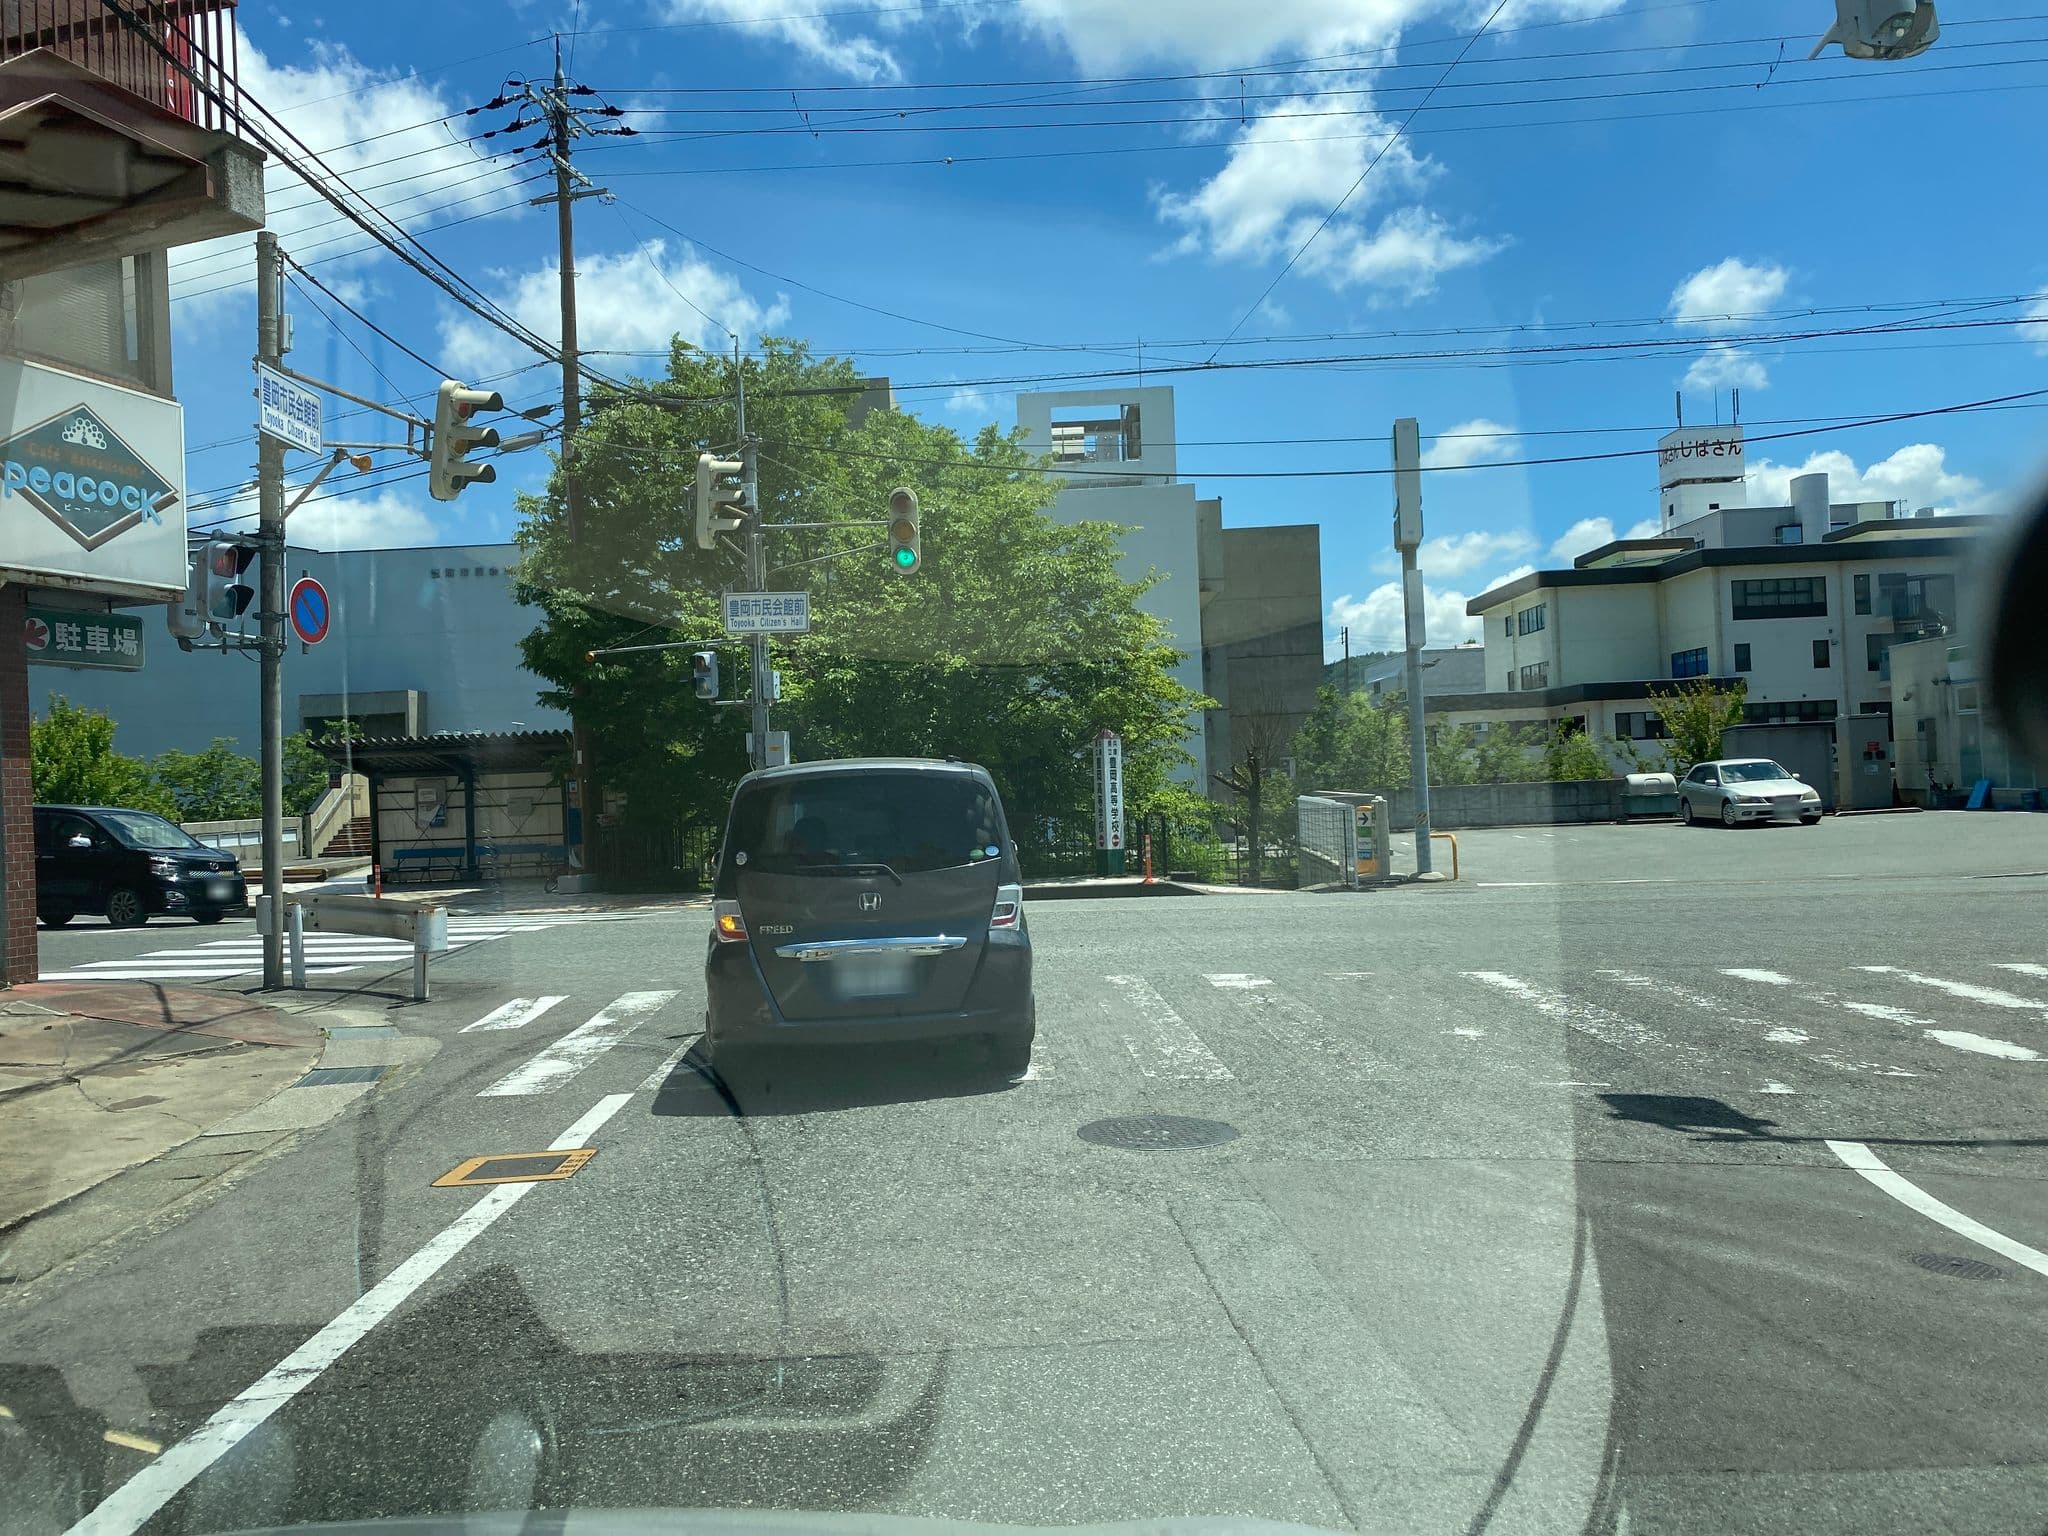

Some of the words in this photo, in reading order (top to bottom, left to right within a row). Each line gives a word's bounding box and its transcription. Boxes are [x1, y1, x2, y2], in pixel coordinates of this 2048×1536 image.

[263, 376, 319, 431] 豊岡市民会館前
[264, 407, 284, 431] Toyooka
[288, 419, 307, 443] Citizen's
[310, 431, 319, 448] Hall
[1681, 438, 1742, 458] じばさん
[4, 460, 161, 526] peacock
[729, 598, 804, 617] 豊岡市民会館前
[730, 618, 755, 628] Toyooka
[760, 617, 787, 627] Citizen's
[791, 617, 803, 626] Hall
[55, 622, 138, 656] 駐車場
[759, 925, 793, 934] FREED
